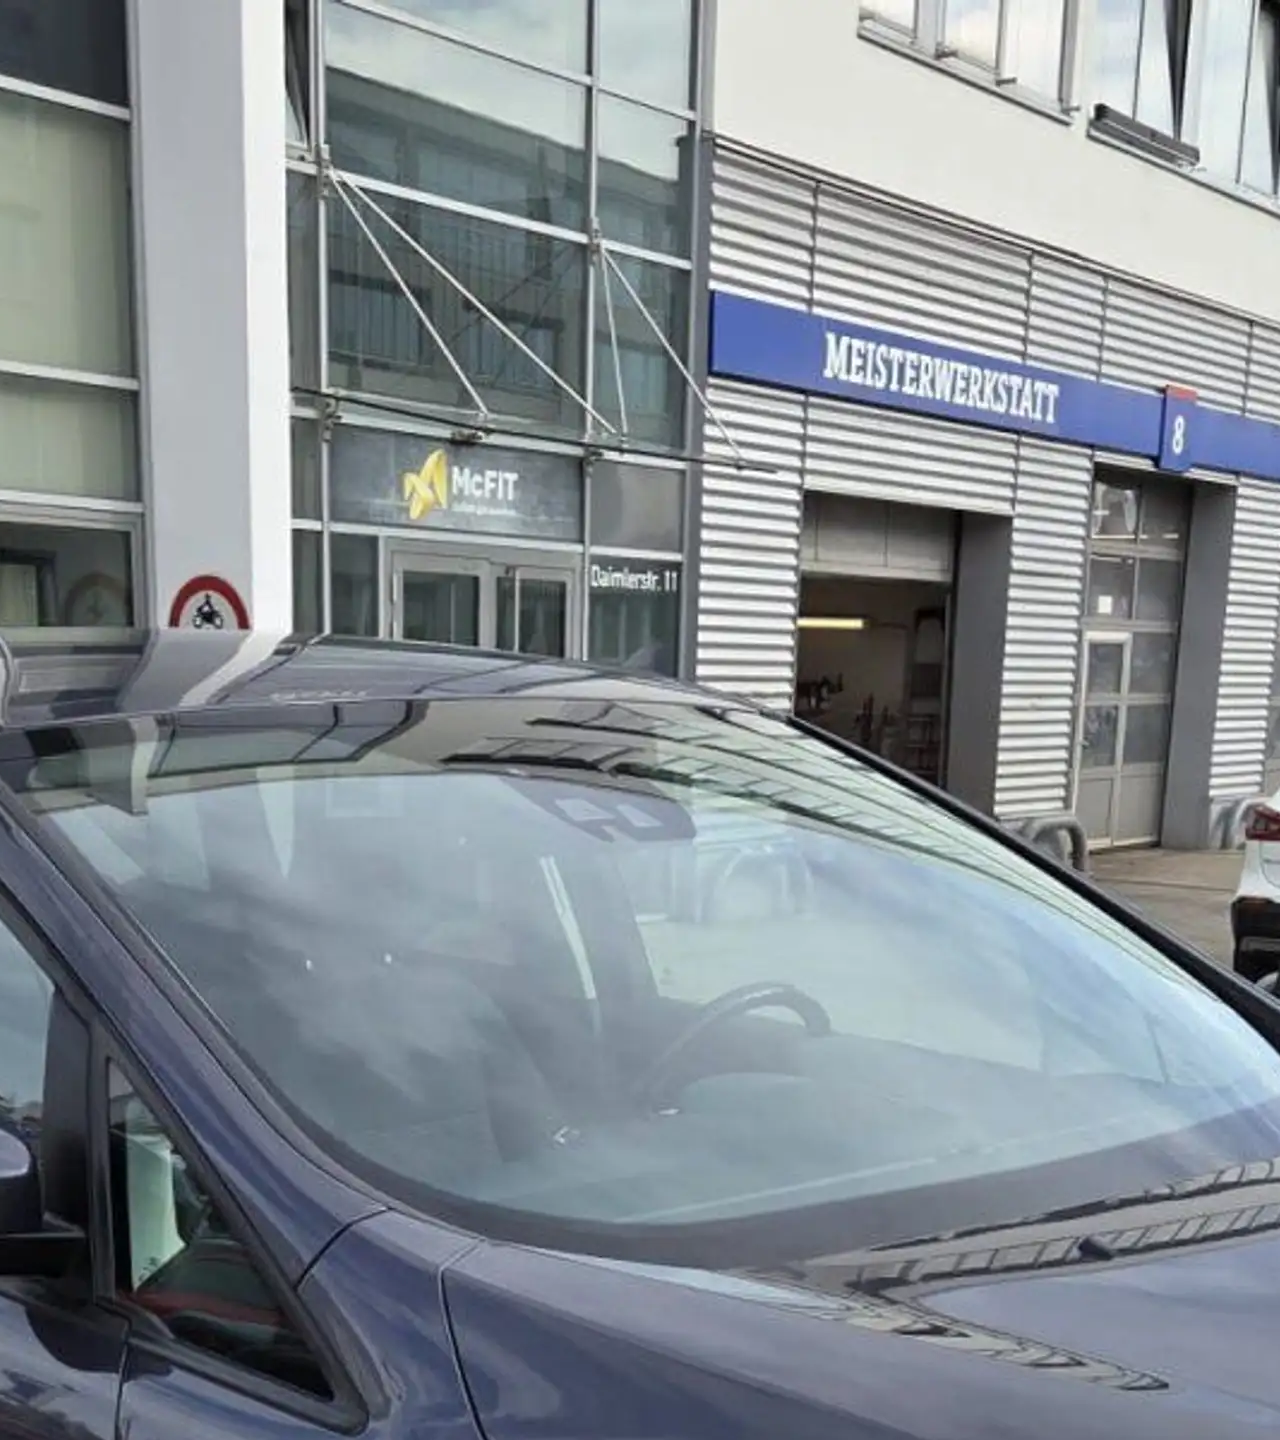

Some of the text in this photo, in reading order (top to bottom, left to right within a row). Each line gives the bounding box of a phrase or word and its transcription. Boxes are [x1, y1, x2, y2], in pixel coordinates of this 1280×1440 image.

[823, 331, 1060, 424] MEISTERWERKSTATT
[1172, 415, 1185, 454] 8
[452, 466, 519, 500] McFIT
[591, 564, 678, 592] Daimlerstr. 11
